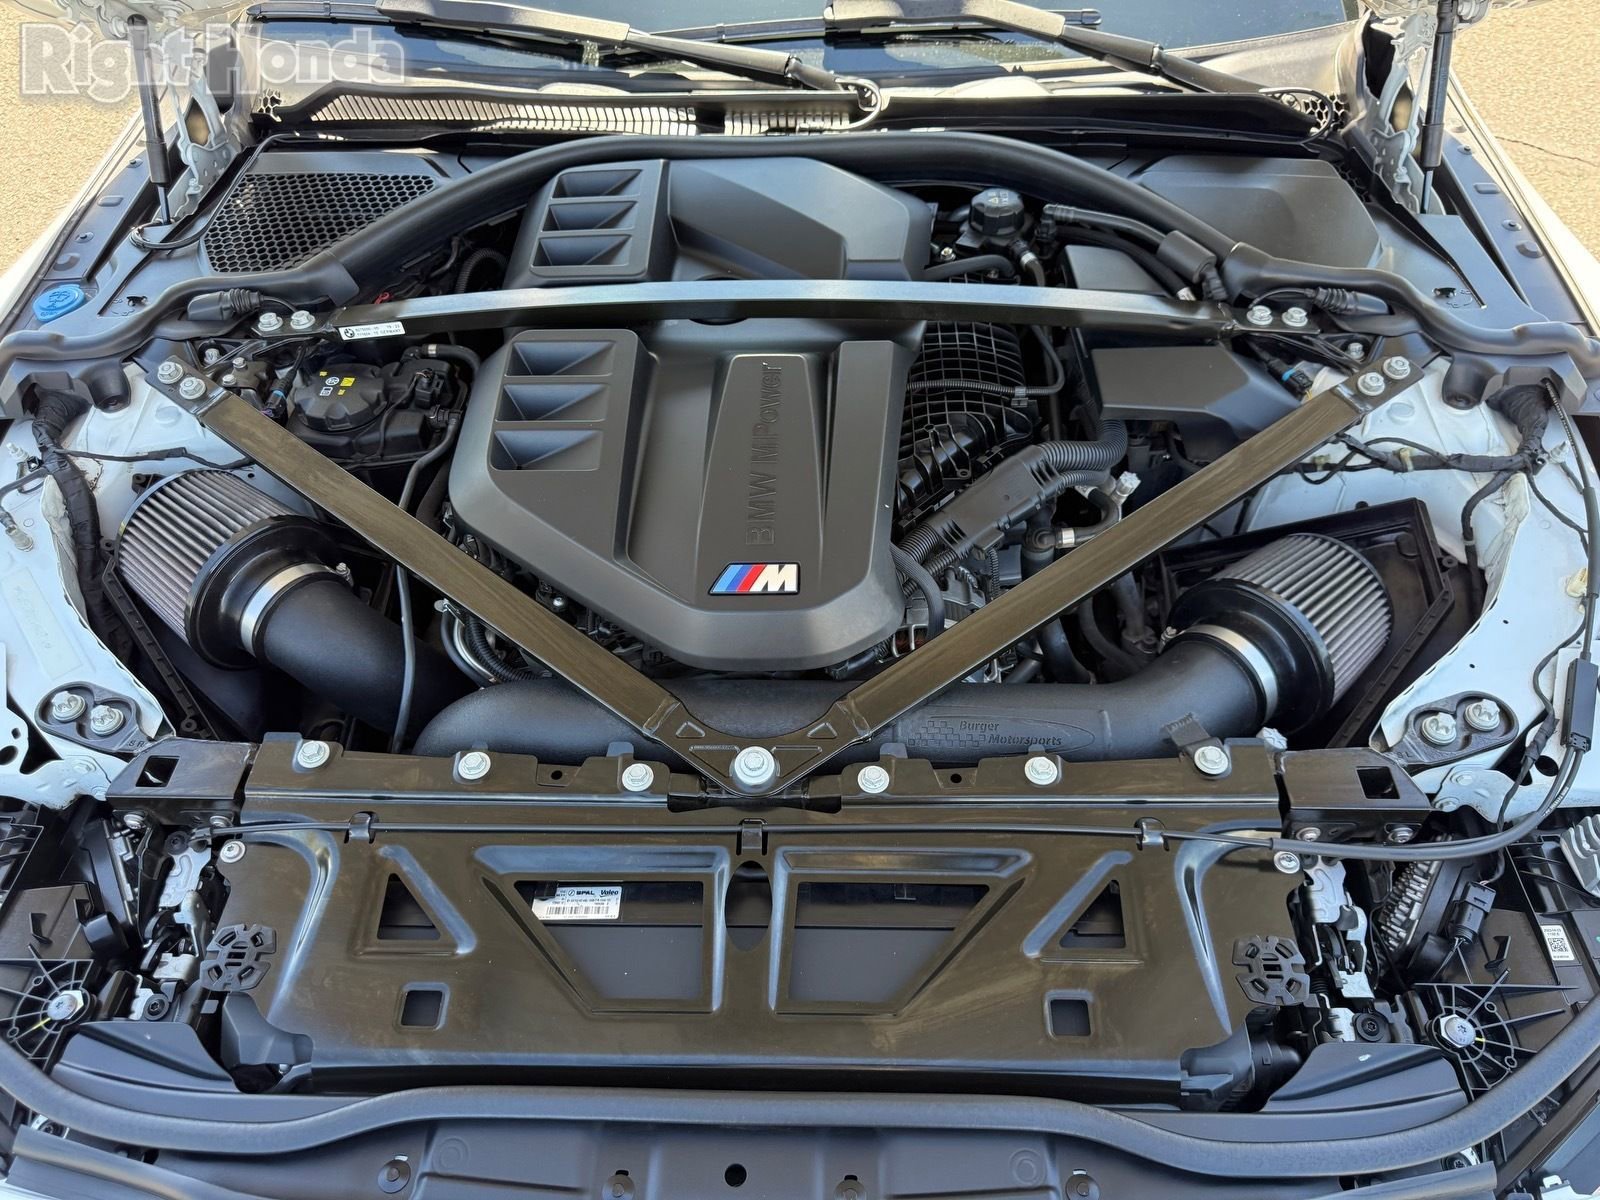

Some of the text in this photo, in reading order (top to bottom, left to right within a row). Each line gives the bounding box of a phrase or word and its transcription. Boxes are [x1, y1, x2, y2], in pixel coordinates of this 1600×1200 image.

[745, 472, 777, 545] BMW
[750, 563, 798, 592] M
[959, 720, 1000, 732] Burger
[987, 734, 1063, 746] Motorsports
[599, 889, 619, 897] Valeo
